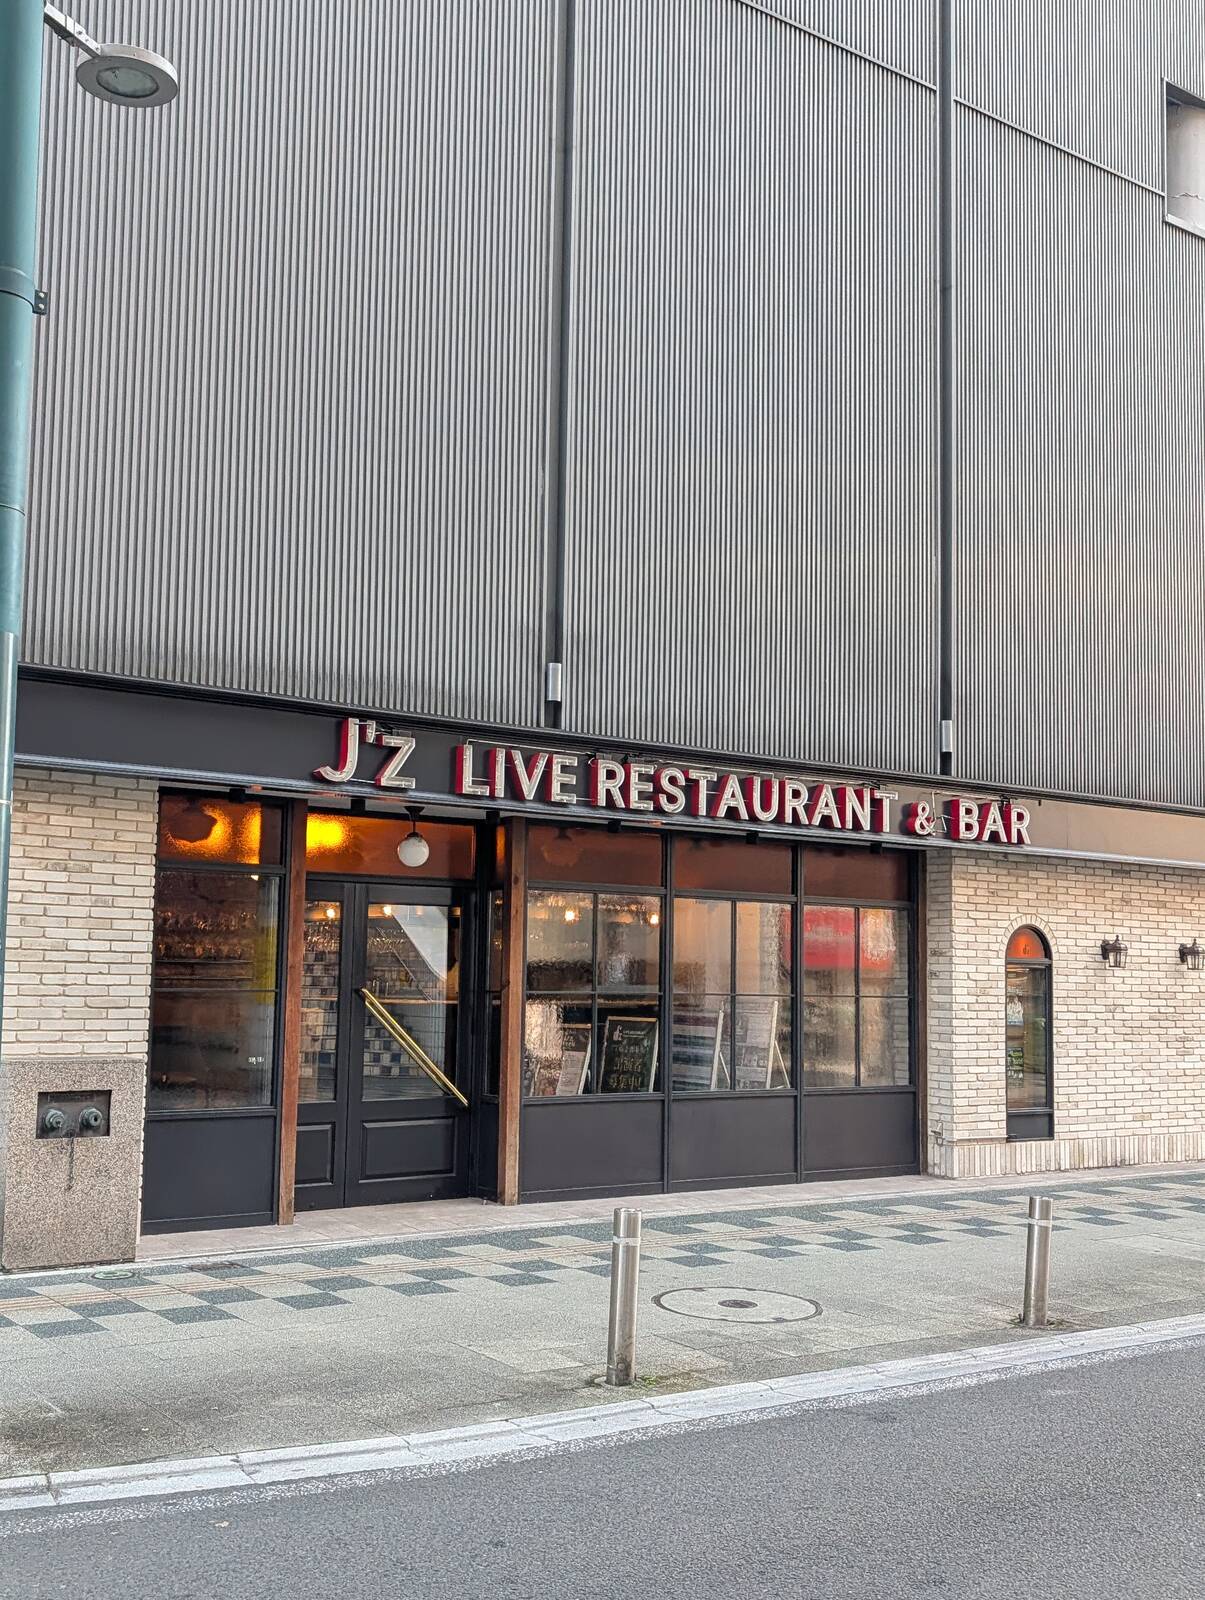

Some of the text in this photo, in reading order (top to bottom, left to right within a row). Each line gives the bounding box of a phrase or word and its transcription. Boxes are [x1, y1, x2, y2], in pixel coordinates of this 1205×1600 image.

[458, 744, 578, 804] LIVE
[592, 758, 898, 834] RESTAURANT
[909, 800, 937, 836] &
[955, 798, 1031, 845] BAR
